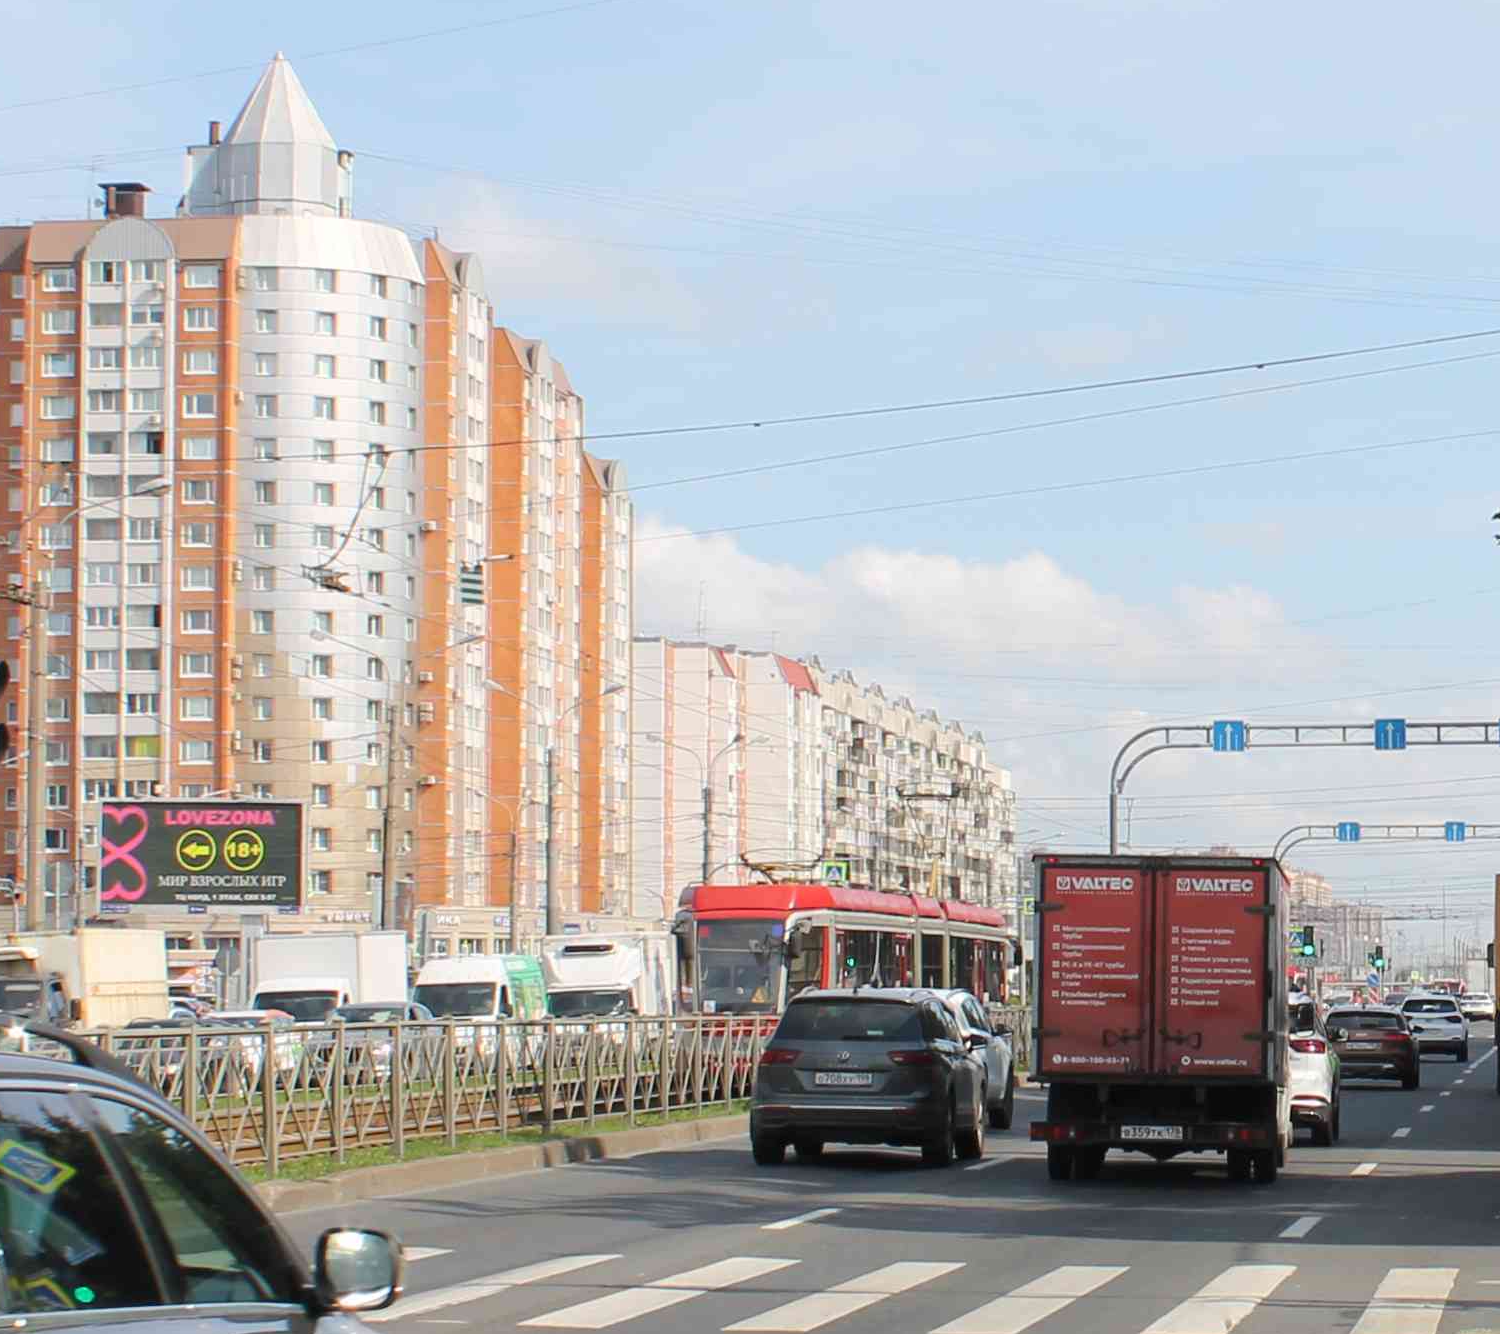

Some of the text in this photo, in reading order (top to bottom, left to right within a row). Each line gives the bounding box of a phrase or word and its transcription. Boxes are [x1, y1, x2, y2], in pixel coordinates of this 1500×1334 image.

[164, 809, 275, 826] LOVEZONA
[227, 841, 262, 859] 18+
[261, 876, 286, 887] ИГР
[1072, 876, 1134, 891] VALTEC
[1192, 878, 1254, 893] VALTEC
